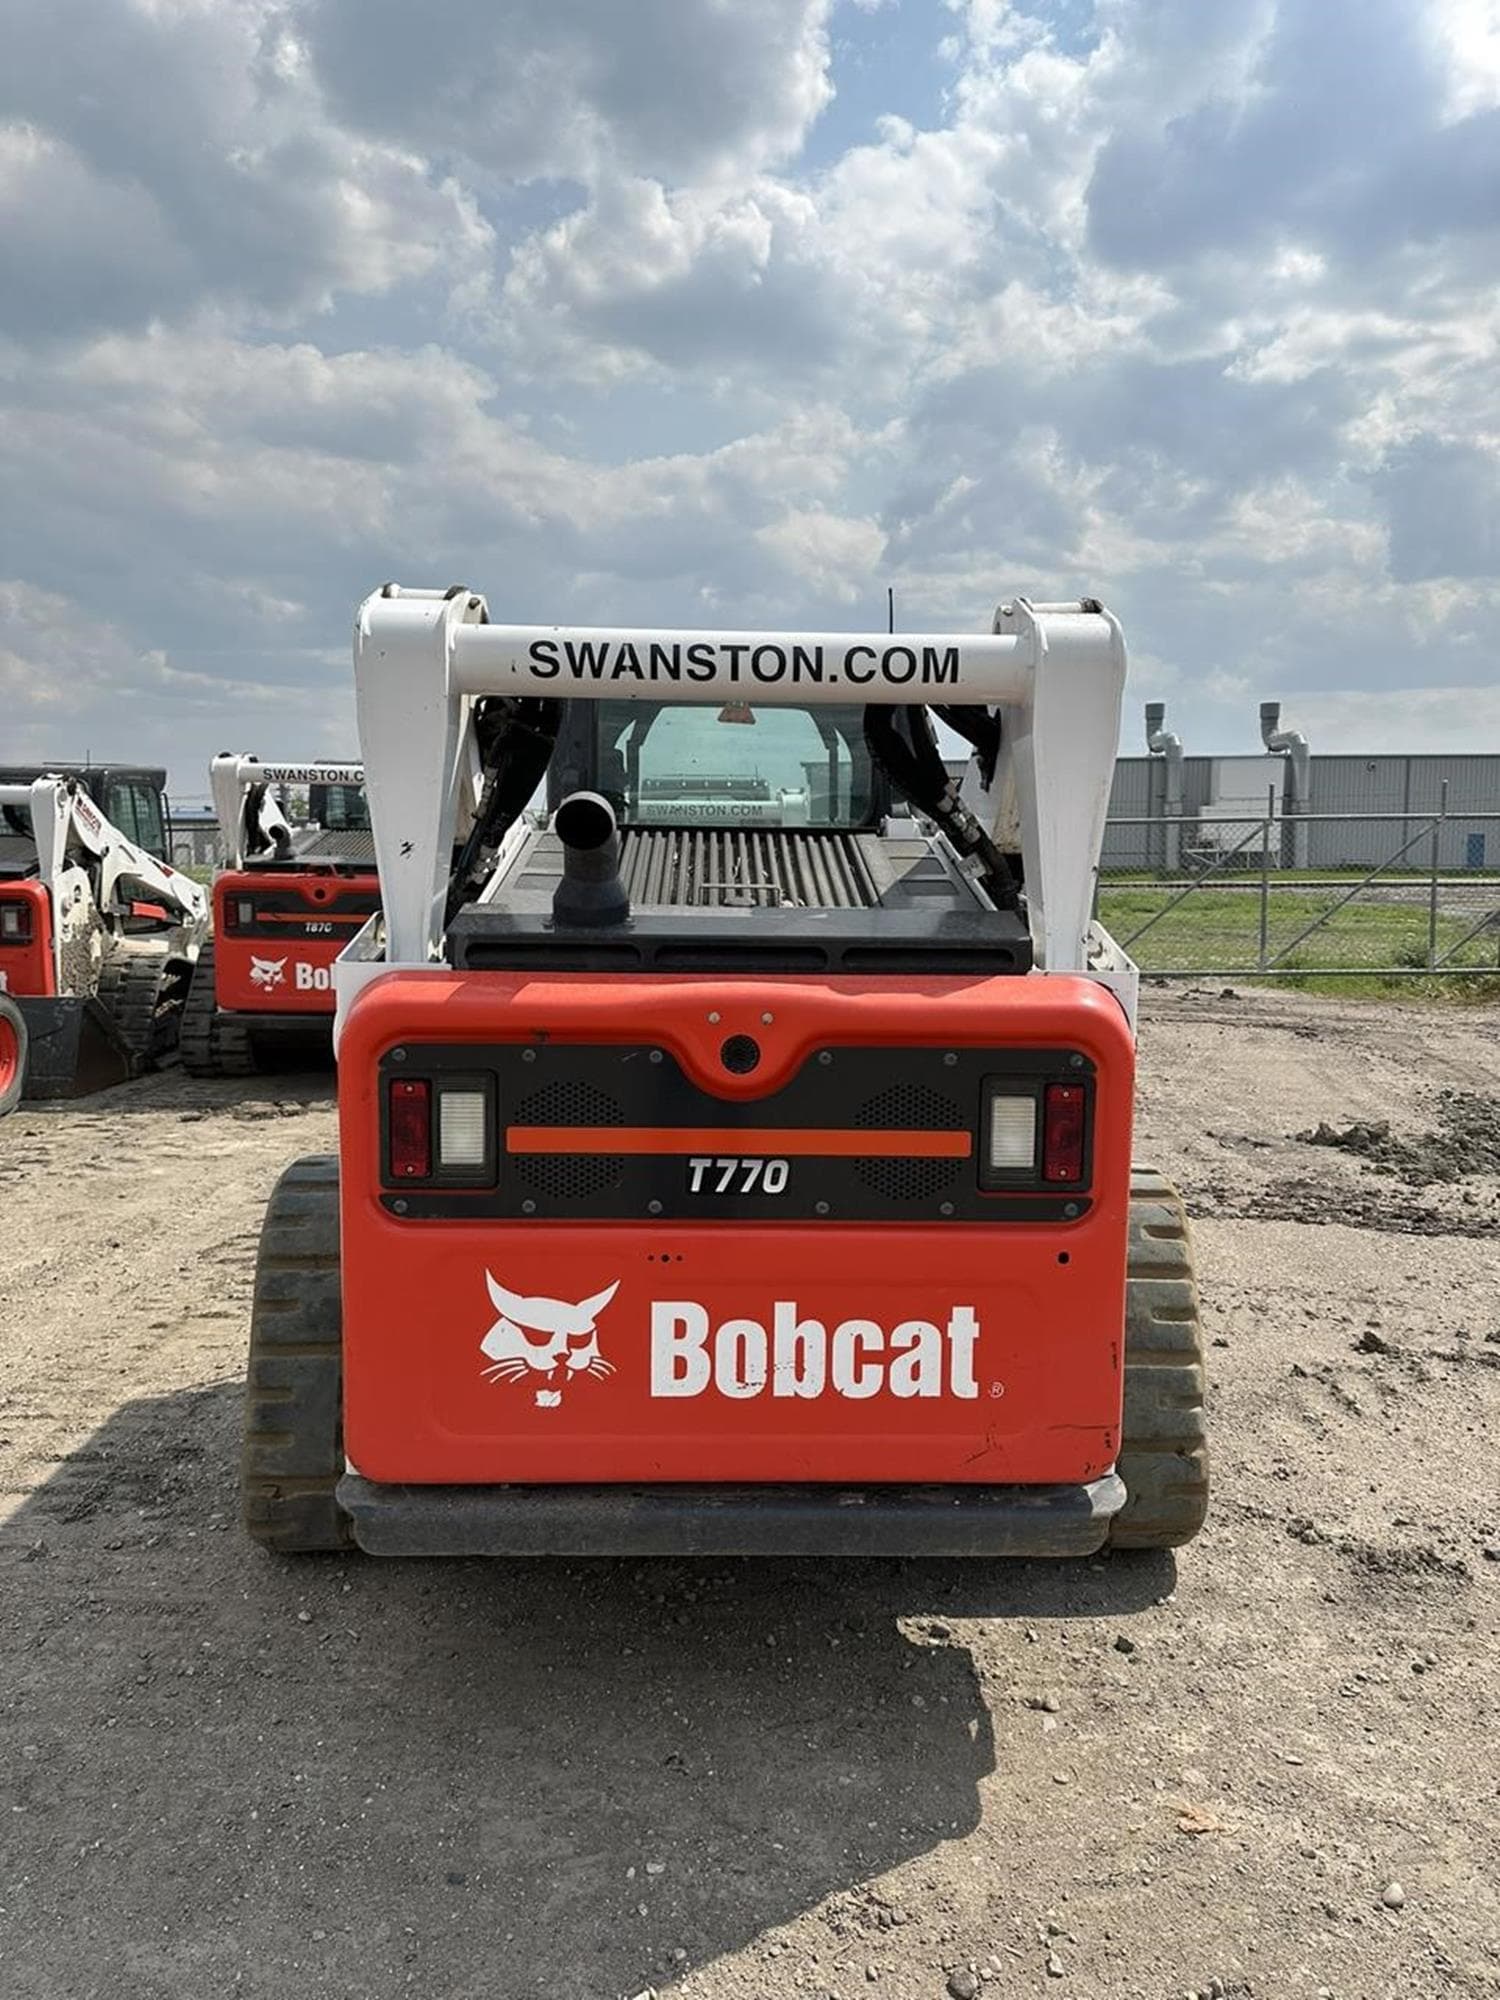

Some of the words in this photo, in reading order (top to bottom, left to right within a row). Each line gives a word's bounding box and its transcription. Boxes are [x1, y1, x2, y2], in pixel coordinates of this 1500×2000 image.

[528, 640, 960, 684] SWANSTON.COM
[263, 768, 364, 782] SWANSTON.C
[646, 804, 764, 817] SWANSTON.COM
[689, 1158, 790, 1194] T770
[650, 1301, 980, 1399] Bobcat
